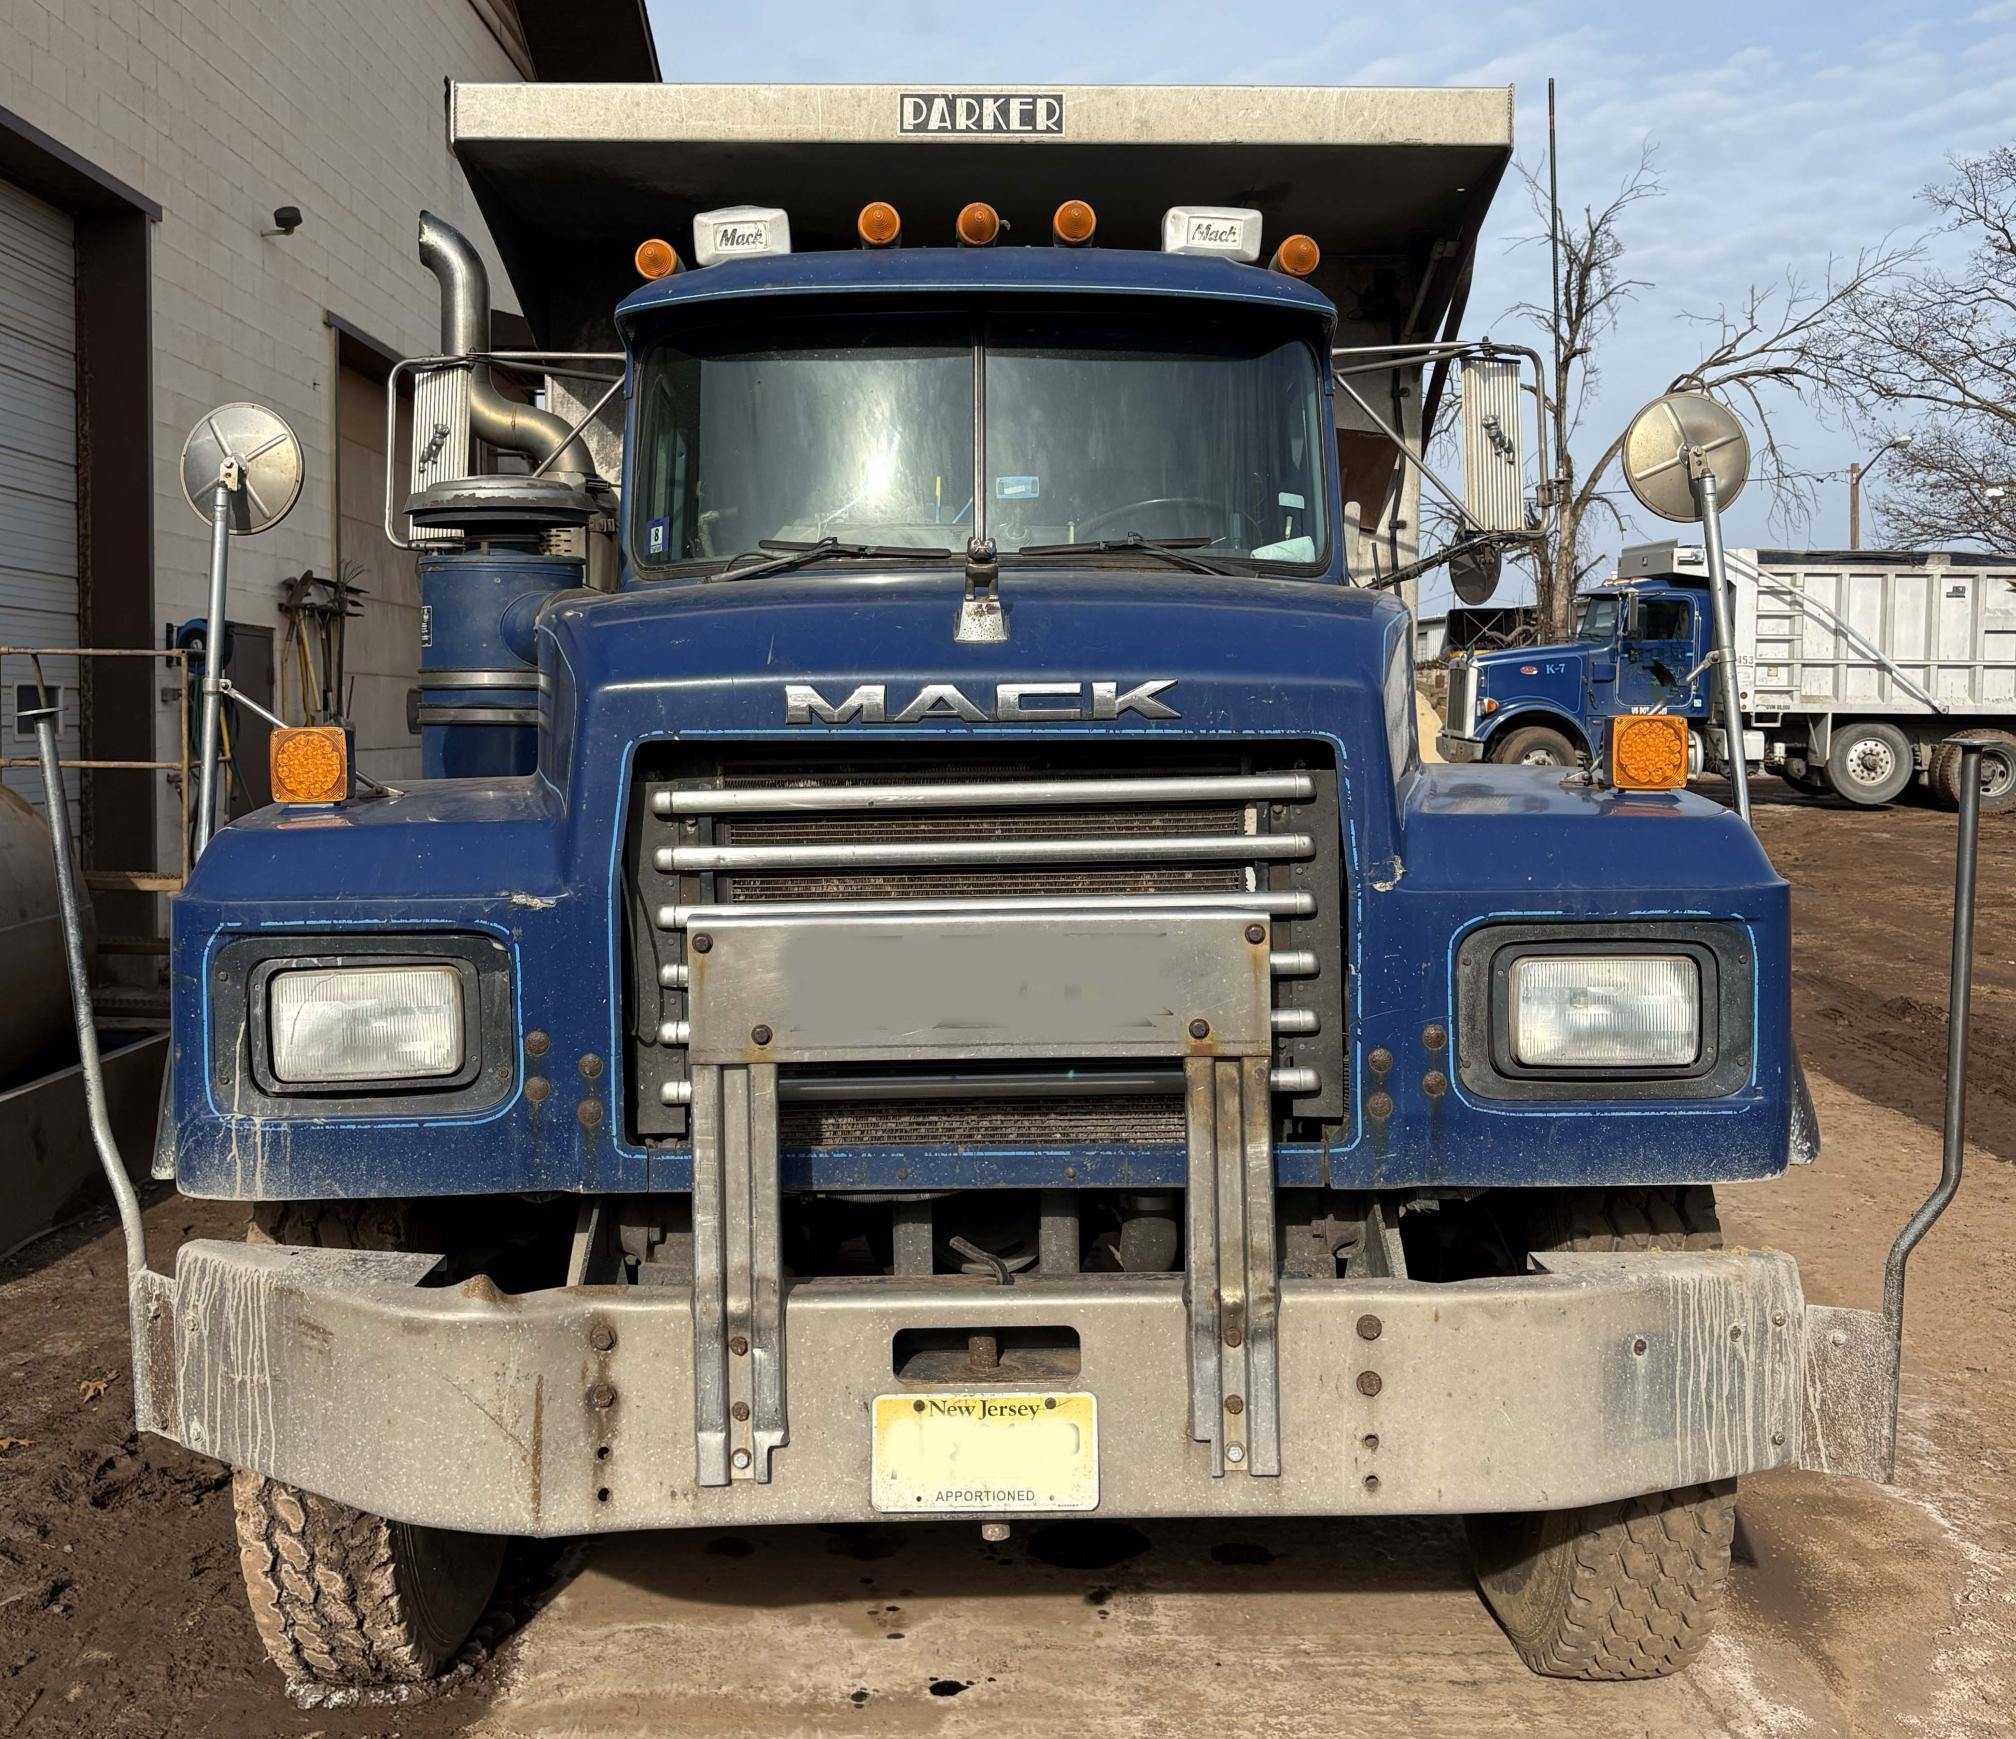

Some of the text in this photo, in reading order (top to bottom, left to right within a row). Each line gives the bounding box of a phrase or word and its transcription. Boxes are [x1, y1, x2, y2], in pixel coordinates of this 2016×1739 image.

[903, 97, 1059, 130] PARKER
[719, 228, 763, 247] Mack
[1192, 223, 1237, 242] Mack
[1546, 663, 1566, 675] K-7
[785, 678, 1181, 724] MACK
[928, 1399, 1040, 1421] New Jersey
[935, 1490, 1036, 1502] APPORTIONED
